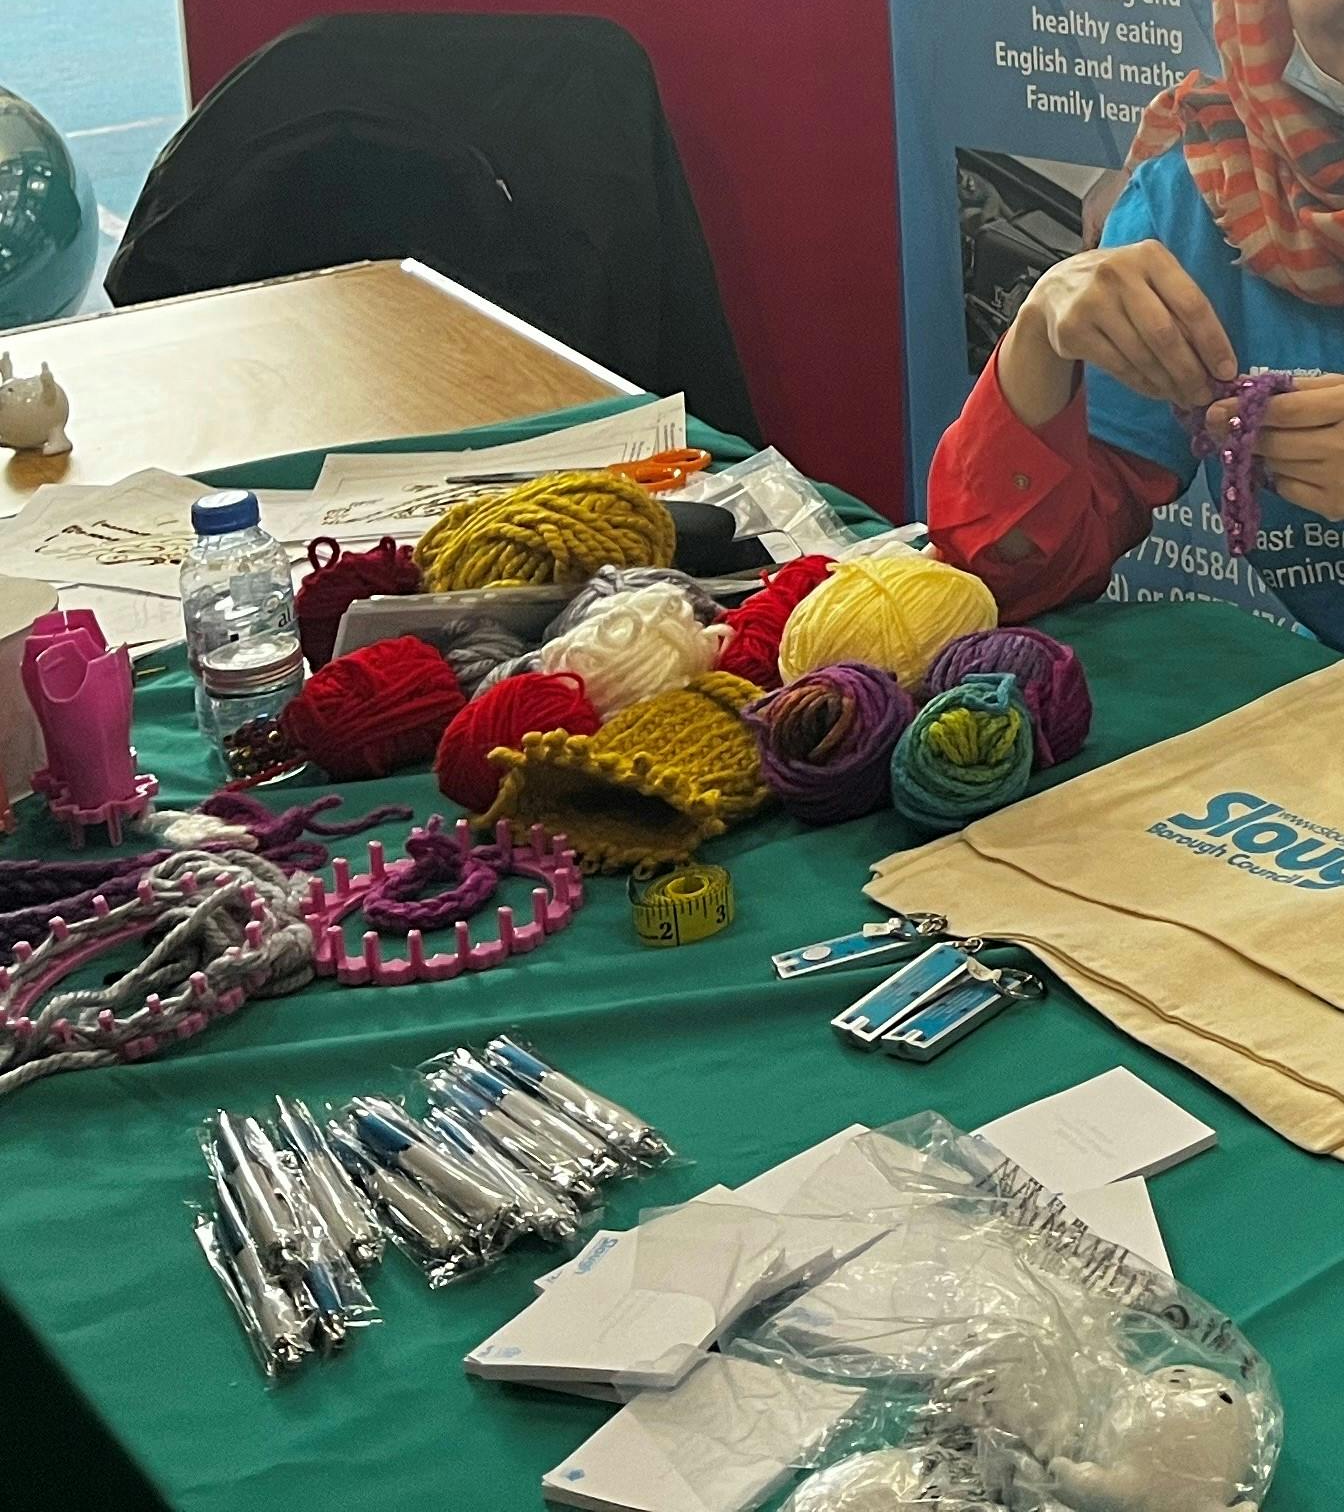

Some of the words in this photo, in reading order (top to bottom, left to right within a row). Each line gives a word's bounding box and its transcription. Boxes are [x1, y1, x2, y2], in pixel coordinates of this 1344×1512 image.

[1032, 5, 1109, 44] healthy
[1116, 20, 1183, 54] eating
[995, 41, 1067, 76] English
[1074, 54, 1112, 80] and
[1027, 85, 1093, 122] Family
[1146, 822, 1227, 858] Borough
[1227, 853, 1304, 886] Council
[660, 922, 673, 940] 2
[716, 904, 726, 924] 3
